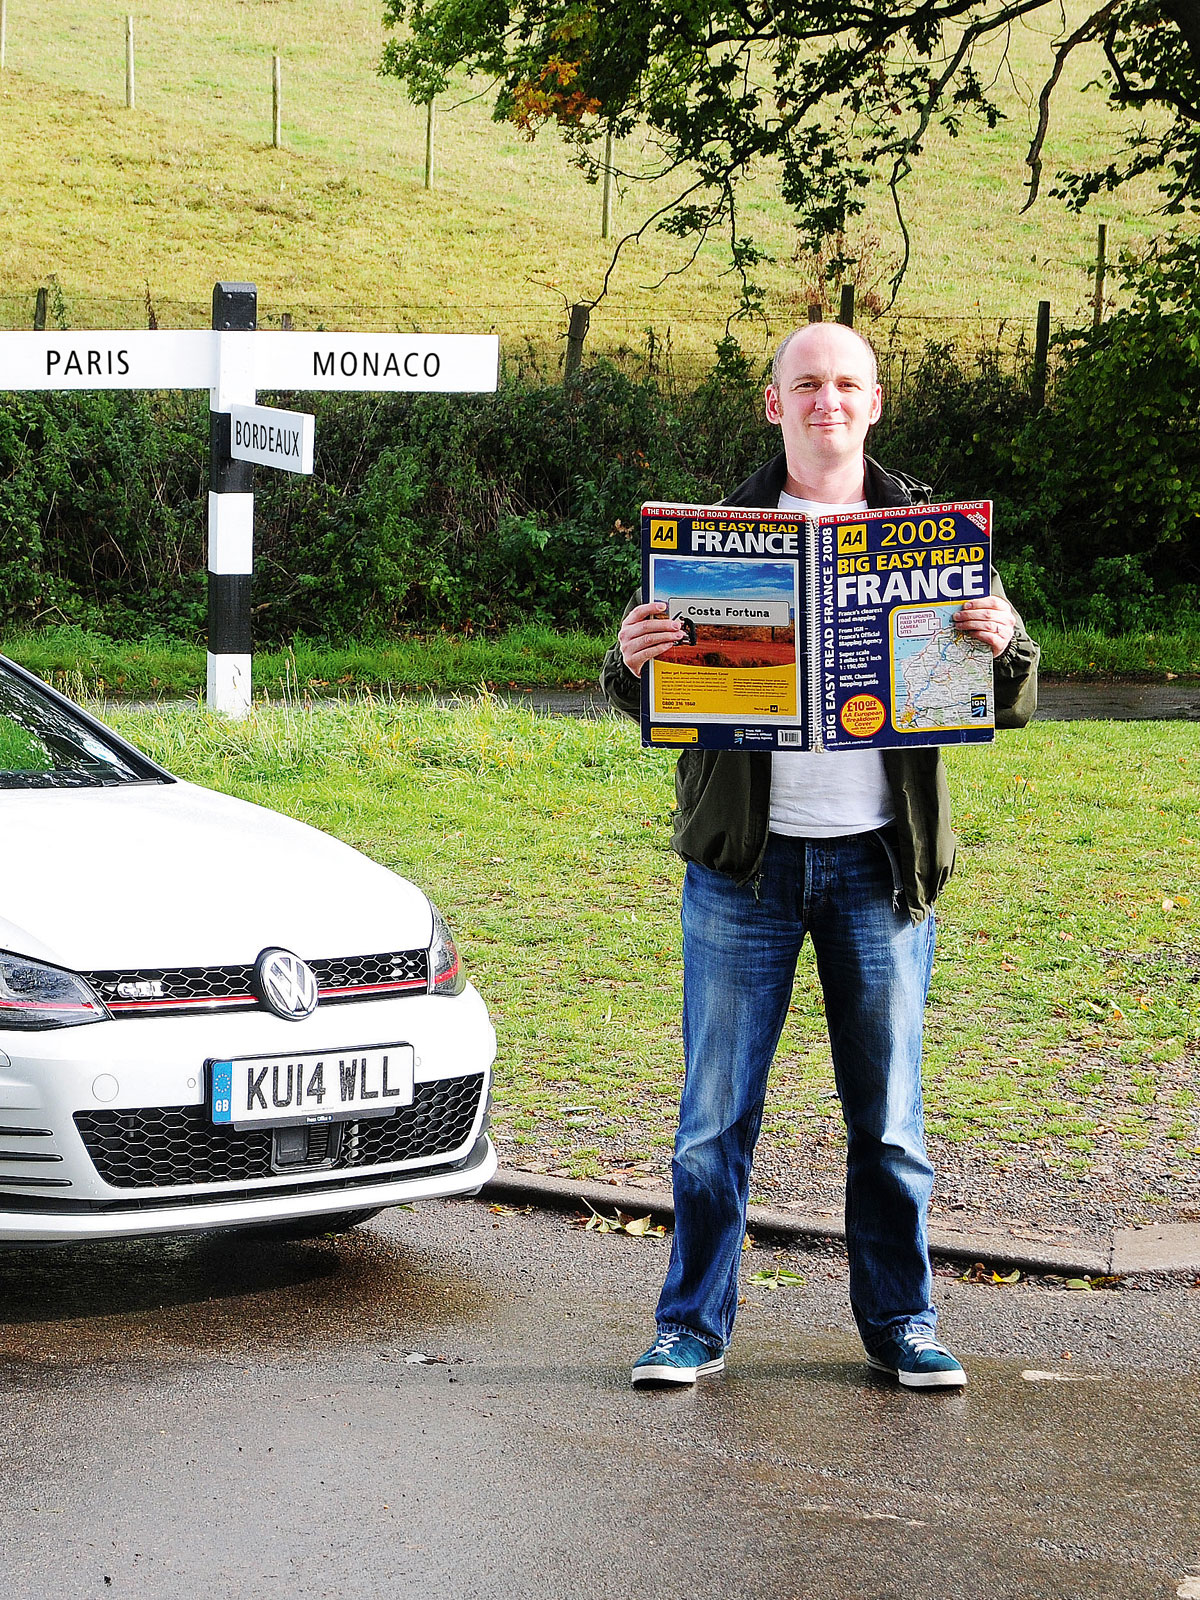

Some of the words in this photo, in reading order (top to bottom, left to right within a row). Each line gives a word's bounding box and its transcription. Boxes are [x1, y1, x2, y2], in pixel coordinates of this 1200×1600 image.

[46, 350, 130, 375] PARIS
[313, 351, 441, 378] MONACO
[235, 420, 300, 457] BORDEAUX
[662, 509, 705, 517] TOP-SELLING
[820, 516, 835, 524] THE
[836, 511, 883, 522] TOP-SELLING
[884, 509, 907, 518] ROAD
[908, 506, 940, 515] ATLASES
[942, 504, 953, 512] OF
[954, 502, 984, 511] FRANCE
[966, 513, 987, 531] EDITION
[973, 511, 988, 525] 3RD
[653, 526, 675, 542] AA
[691, 521, 716, 531] BIG
[719, 522, 756, 532] EASY
[759, 523, 799, 533] READ
[841, 530, 863, 547] AA
[881, 517, 956, 547] 2008
[691, 531, 799, 554] FRANCE
[822, 527, 833, 562] 2008
[837, 556, 870, 575] BIG
[876, 551, 927, 571] EASY
[930, 546, 985, 566] READ
[822, 565, 834, 624] FRANCE
[837, 564, 984, 608] FRANCE
[688, 606, 721, 616] Costa
[725, 607, 770, 618] Fortuna
[838, 609, 860, 617] France's
[824, 628, 835, 667] READ
[825, 673, 835, 710] EASY
[847, 701, 865, 712] £10
[826, 714, 836, 739] BIG
[246, 1061, 326, 1111] KU14
[339, 1055, 401, 1102] WLL
[215, 1099, 229, 1112] GB
